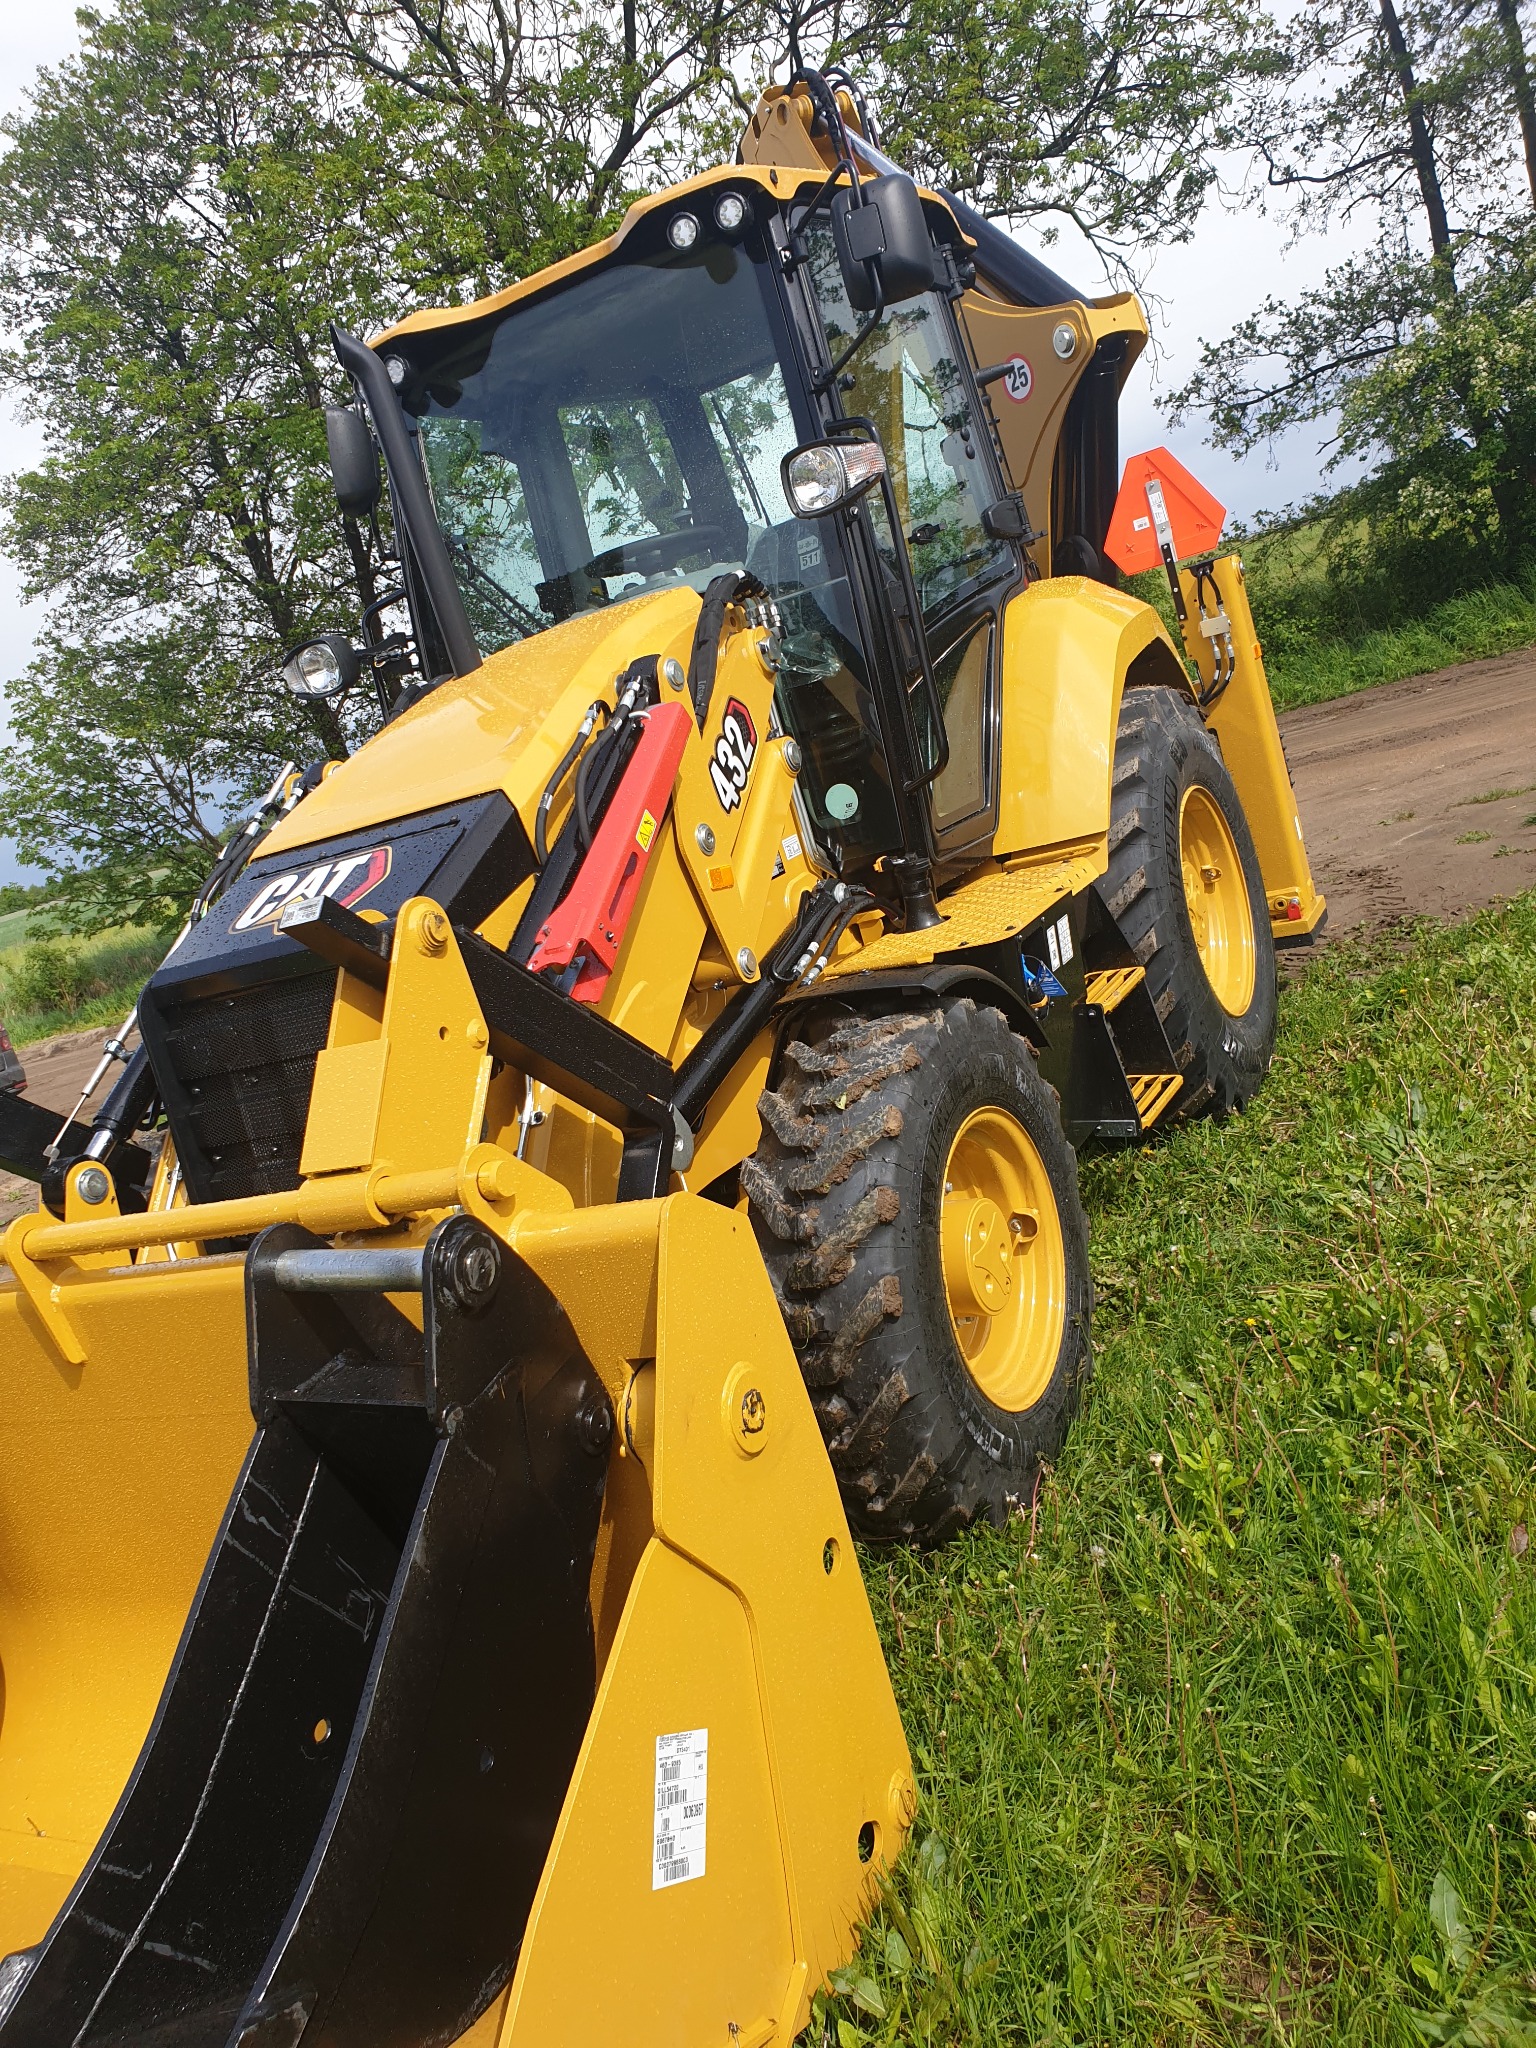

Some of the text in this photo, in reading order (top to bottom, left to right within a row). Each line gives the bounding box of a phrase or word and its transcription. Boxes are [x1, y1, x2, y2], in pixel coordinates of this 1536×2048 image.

[1008, 365, 1029, 393] 25
[802, 552, 818, 567] 511
[710, 714, 754, 813] 432
[235, 852, 373, 930] CAT
